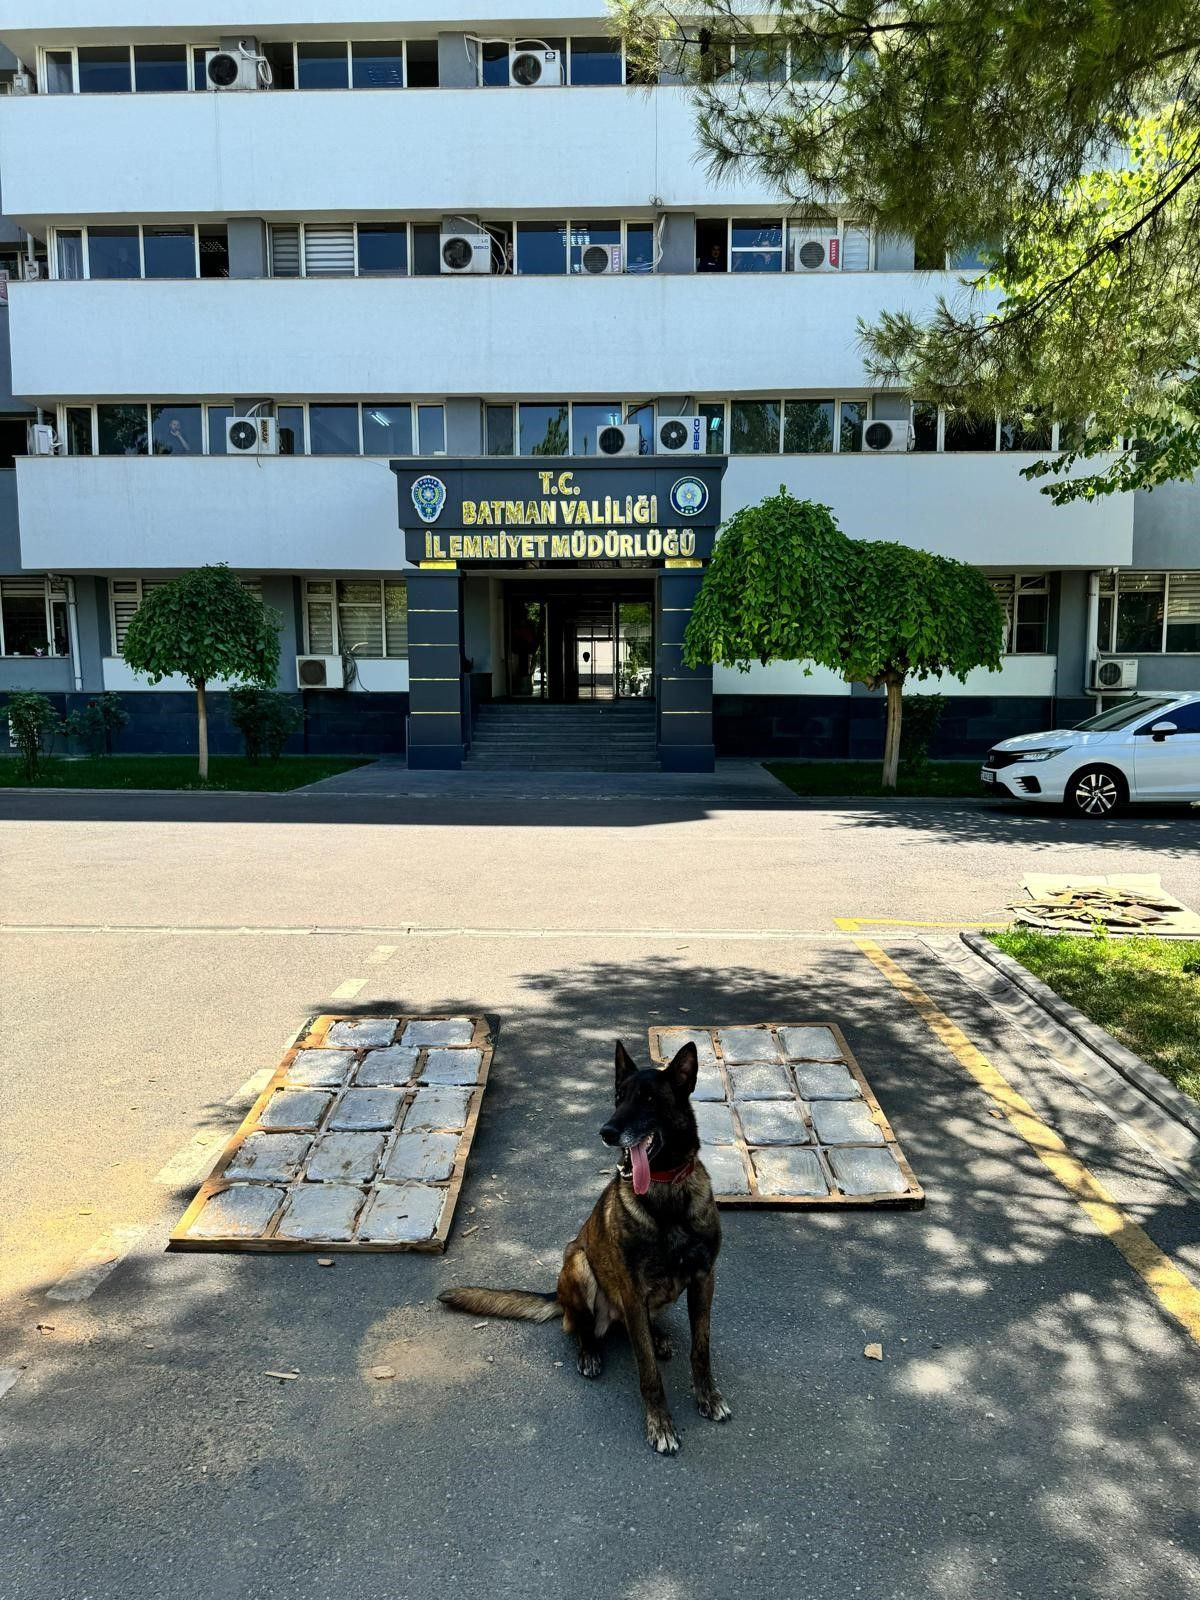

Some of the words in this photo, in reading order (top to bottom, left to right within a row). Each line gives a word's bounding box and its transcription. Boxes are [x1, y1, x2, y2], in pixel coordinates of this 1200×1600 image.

[693, 418, 701, 451] BEKO
[539, 471, 581, 496] T.C.
[462, 500, 557, 525] BATMAN
[560, 494, 658, 525] VALİLİĞİ
[425, 530, 447, 558] İL
[449, 530, 549, 558] EMNİYET
[551, 528, 696, 558] MÜDÜRLÜĞÜ
